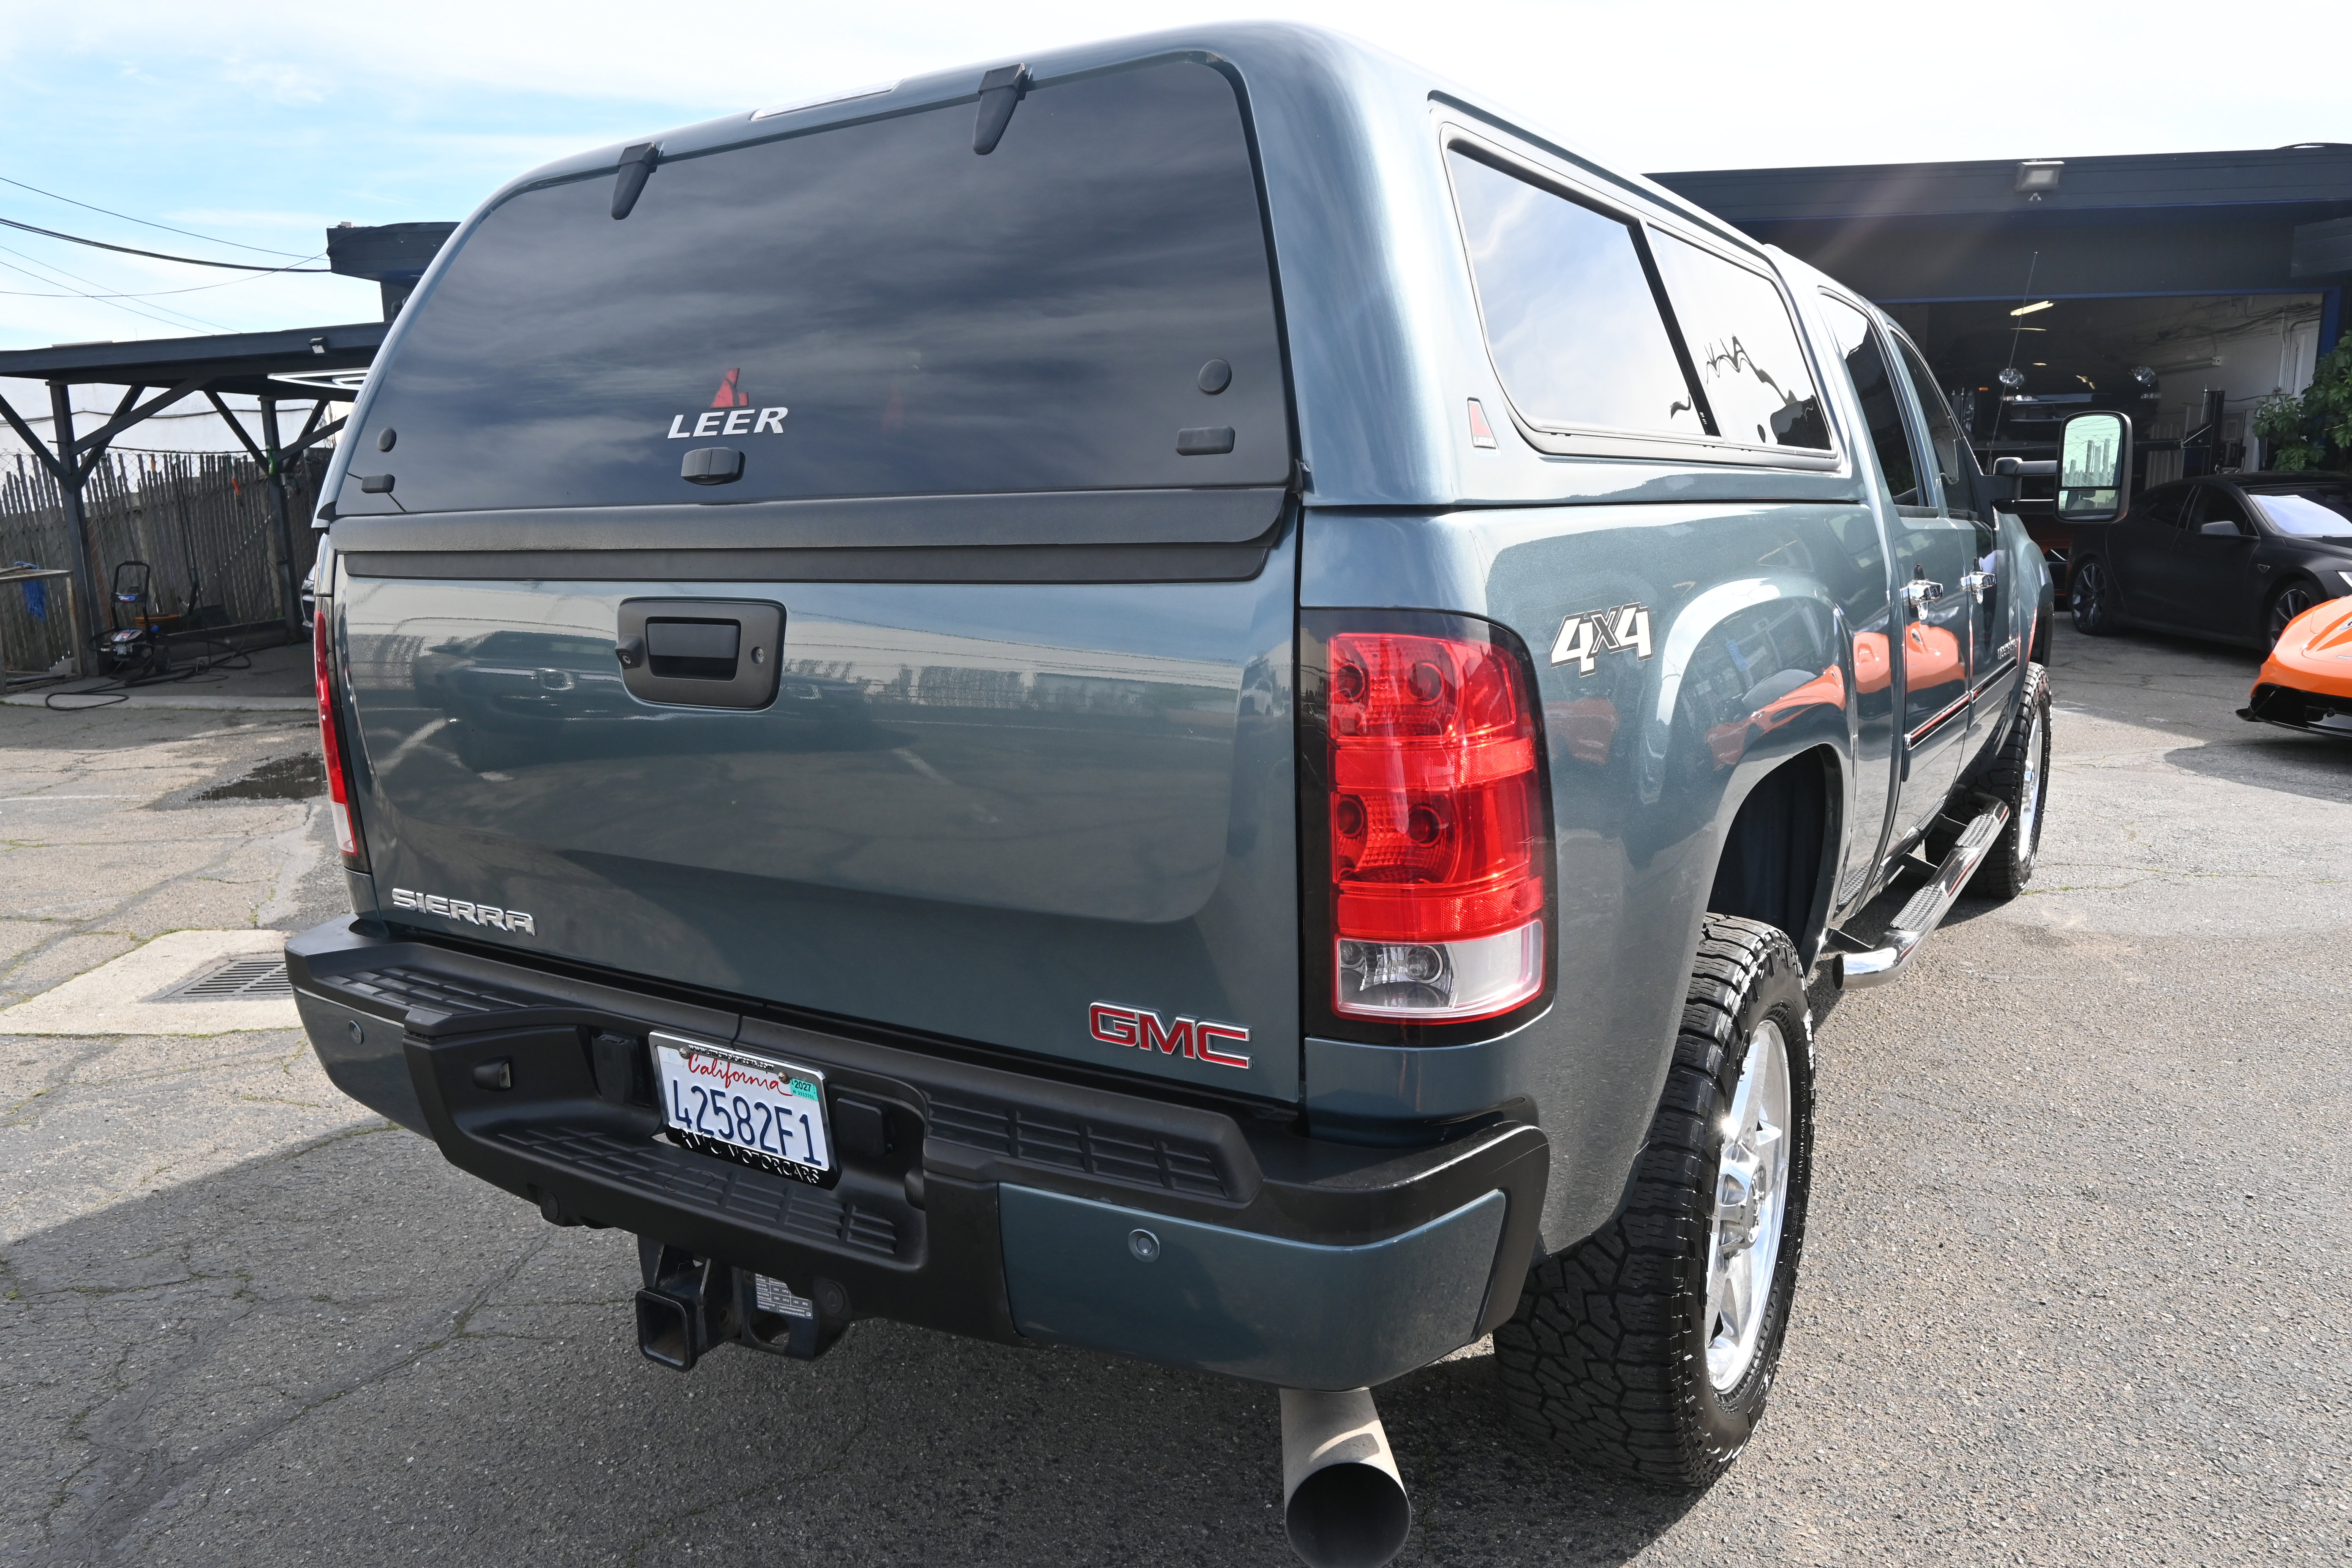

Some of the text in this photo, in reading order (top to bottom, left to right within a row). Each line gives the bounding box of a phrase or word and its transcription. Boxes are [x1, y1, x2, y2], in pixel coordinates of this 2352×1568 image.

[667, 407, 788, 439] LEER
[1474, 436, 1495, 447] LEER
[392, 888, 536, 936] SIERRA
[1089, 1000, 1253, 1070] GMC
[688, 1053, 793, 1097] California
[794, 1080, 811, 1092] 2027
[673, 1080, 822, 1166] 42582F1
